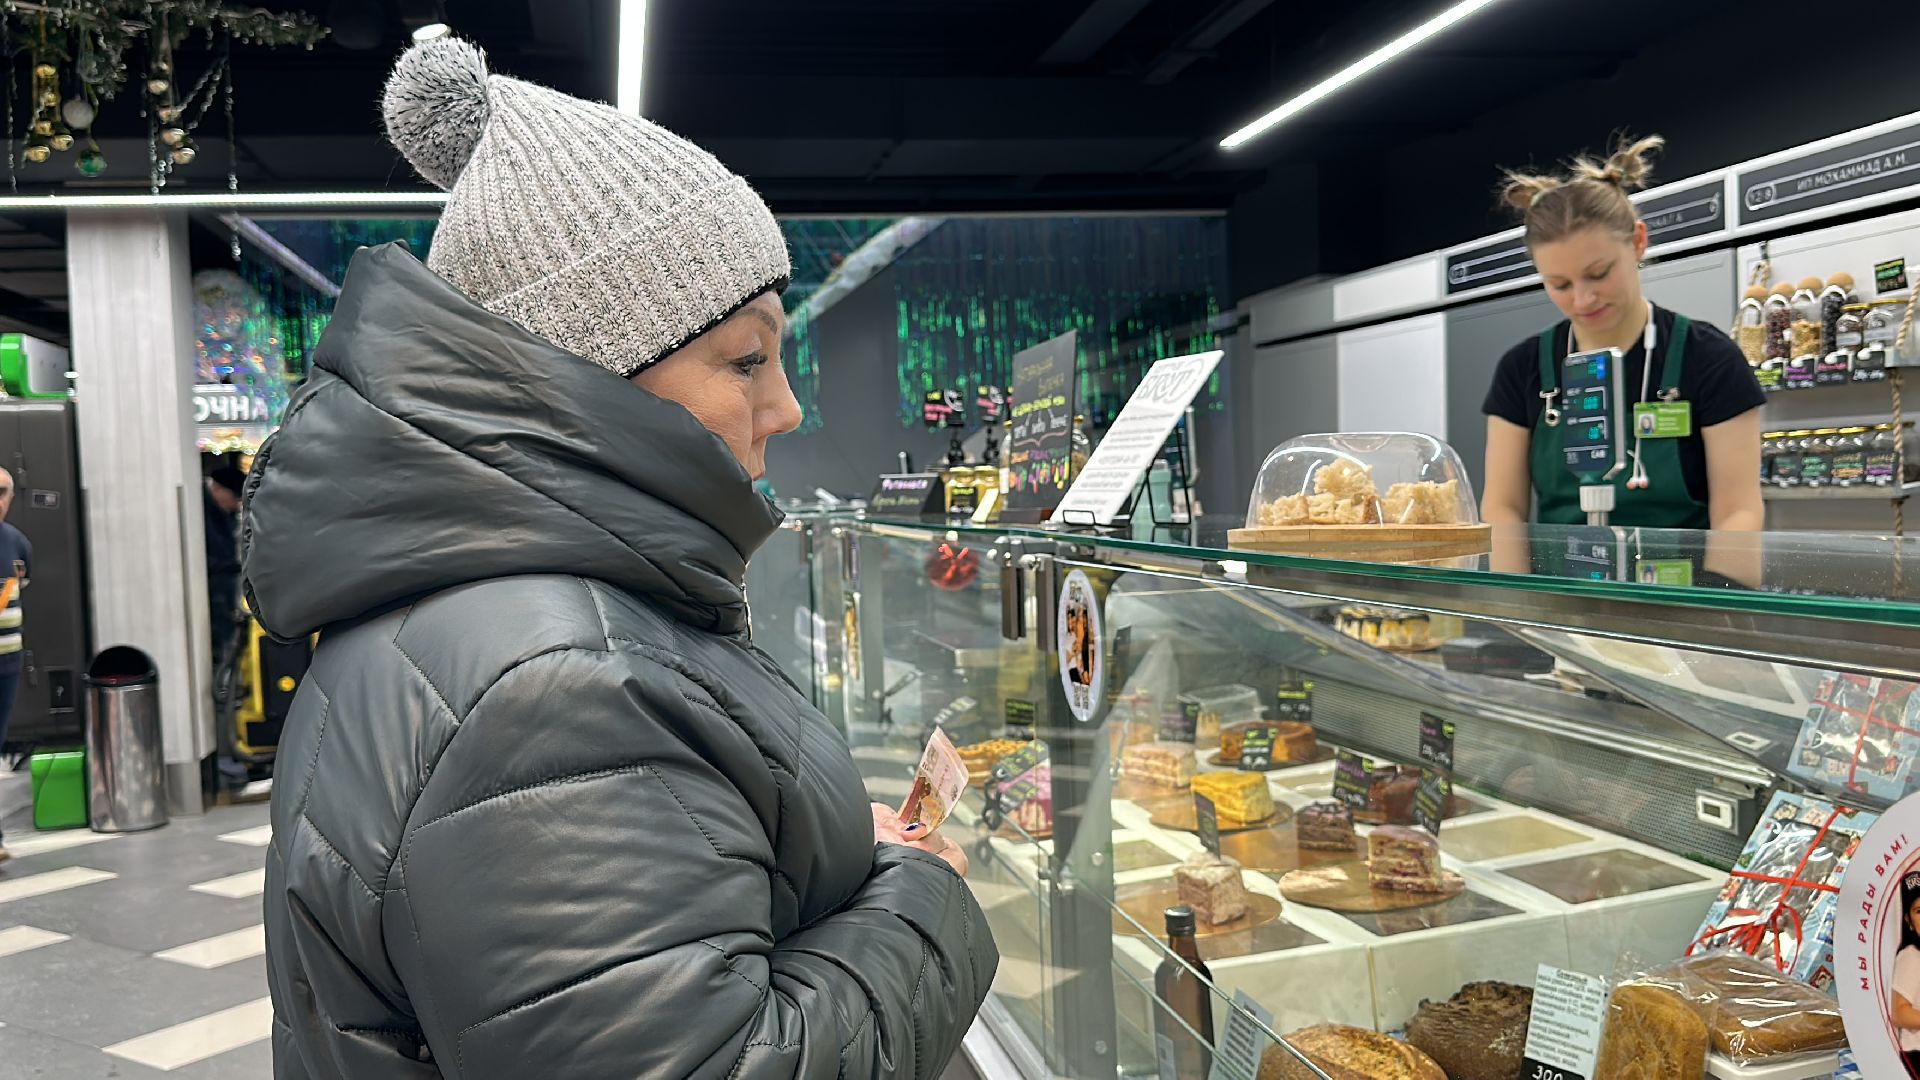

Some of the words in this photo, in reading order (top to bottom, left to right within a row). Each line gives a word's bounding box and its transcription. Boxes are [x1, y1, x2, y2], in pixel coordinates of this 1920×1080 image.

[1814, 160, 1881, 186] МОХАММАД
[1874, 834, 1909, 877] ВАМ!
[1857, 883, 1876, 943] РАДЫ
[1857, 956, 1869, 991] МЫ
